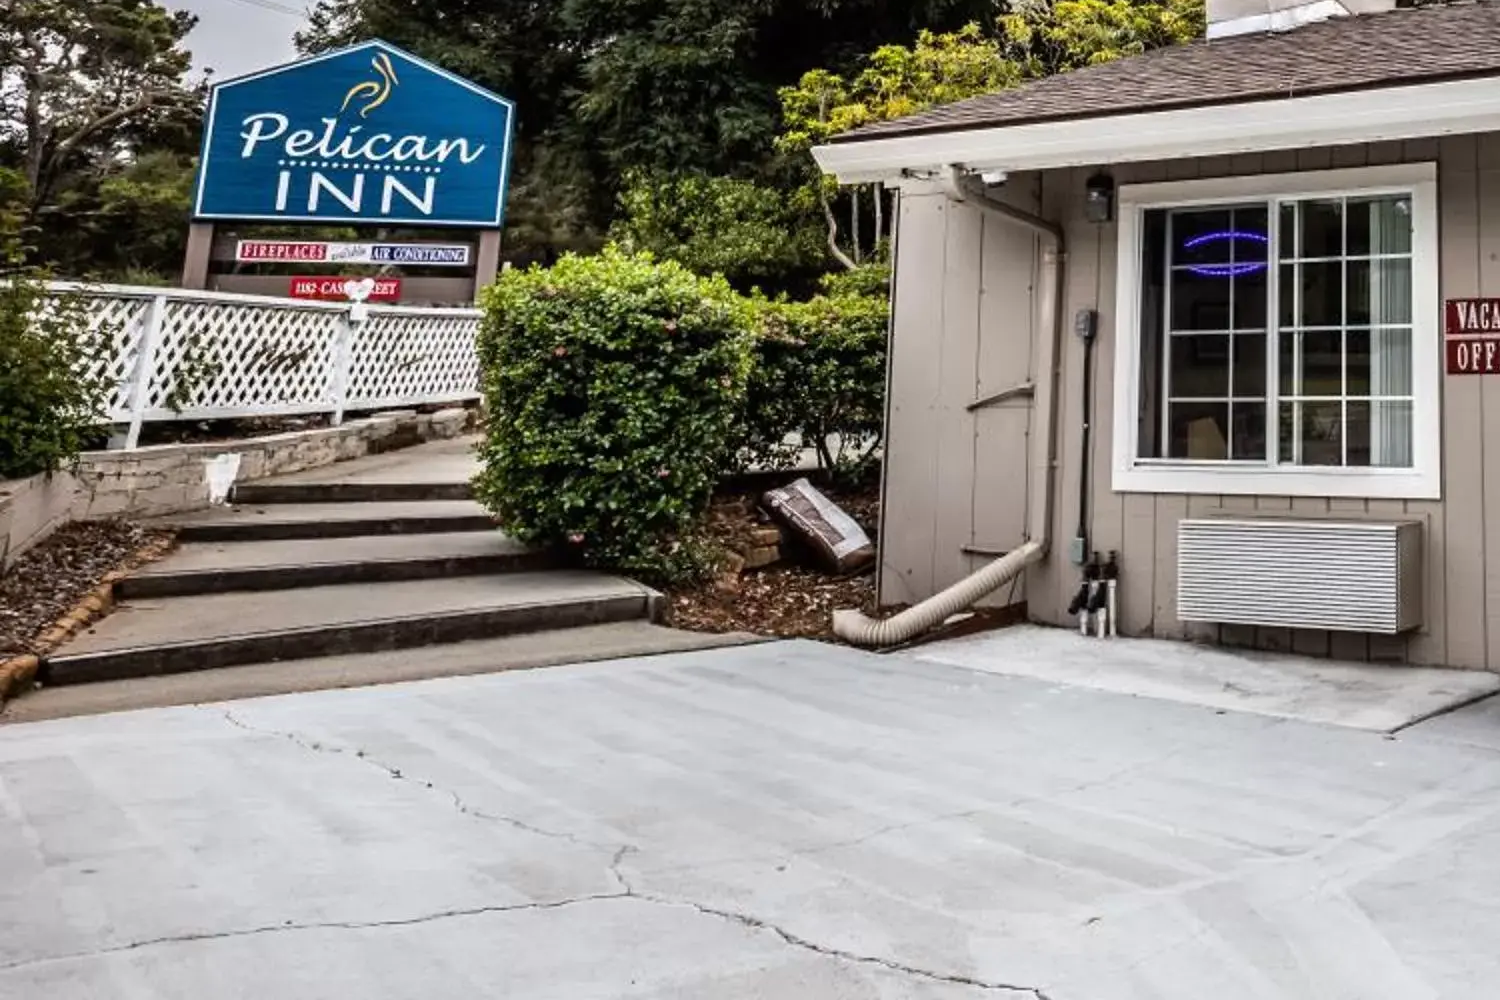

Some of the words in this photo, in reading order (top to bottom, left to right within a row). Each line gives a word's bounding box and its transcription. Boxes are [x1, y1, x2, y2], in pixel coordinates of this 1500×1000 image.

[239, 112, 486, 164] Pelican
[275, 170, 436, 215] INN
[243, 244, 326, 258] FIREPLACES
[371, 246, 390, 258] AIR
[393, 247, 465, 261] CONDITIONING
[320, 281, 346, 294] CAS
